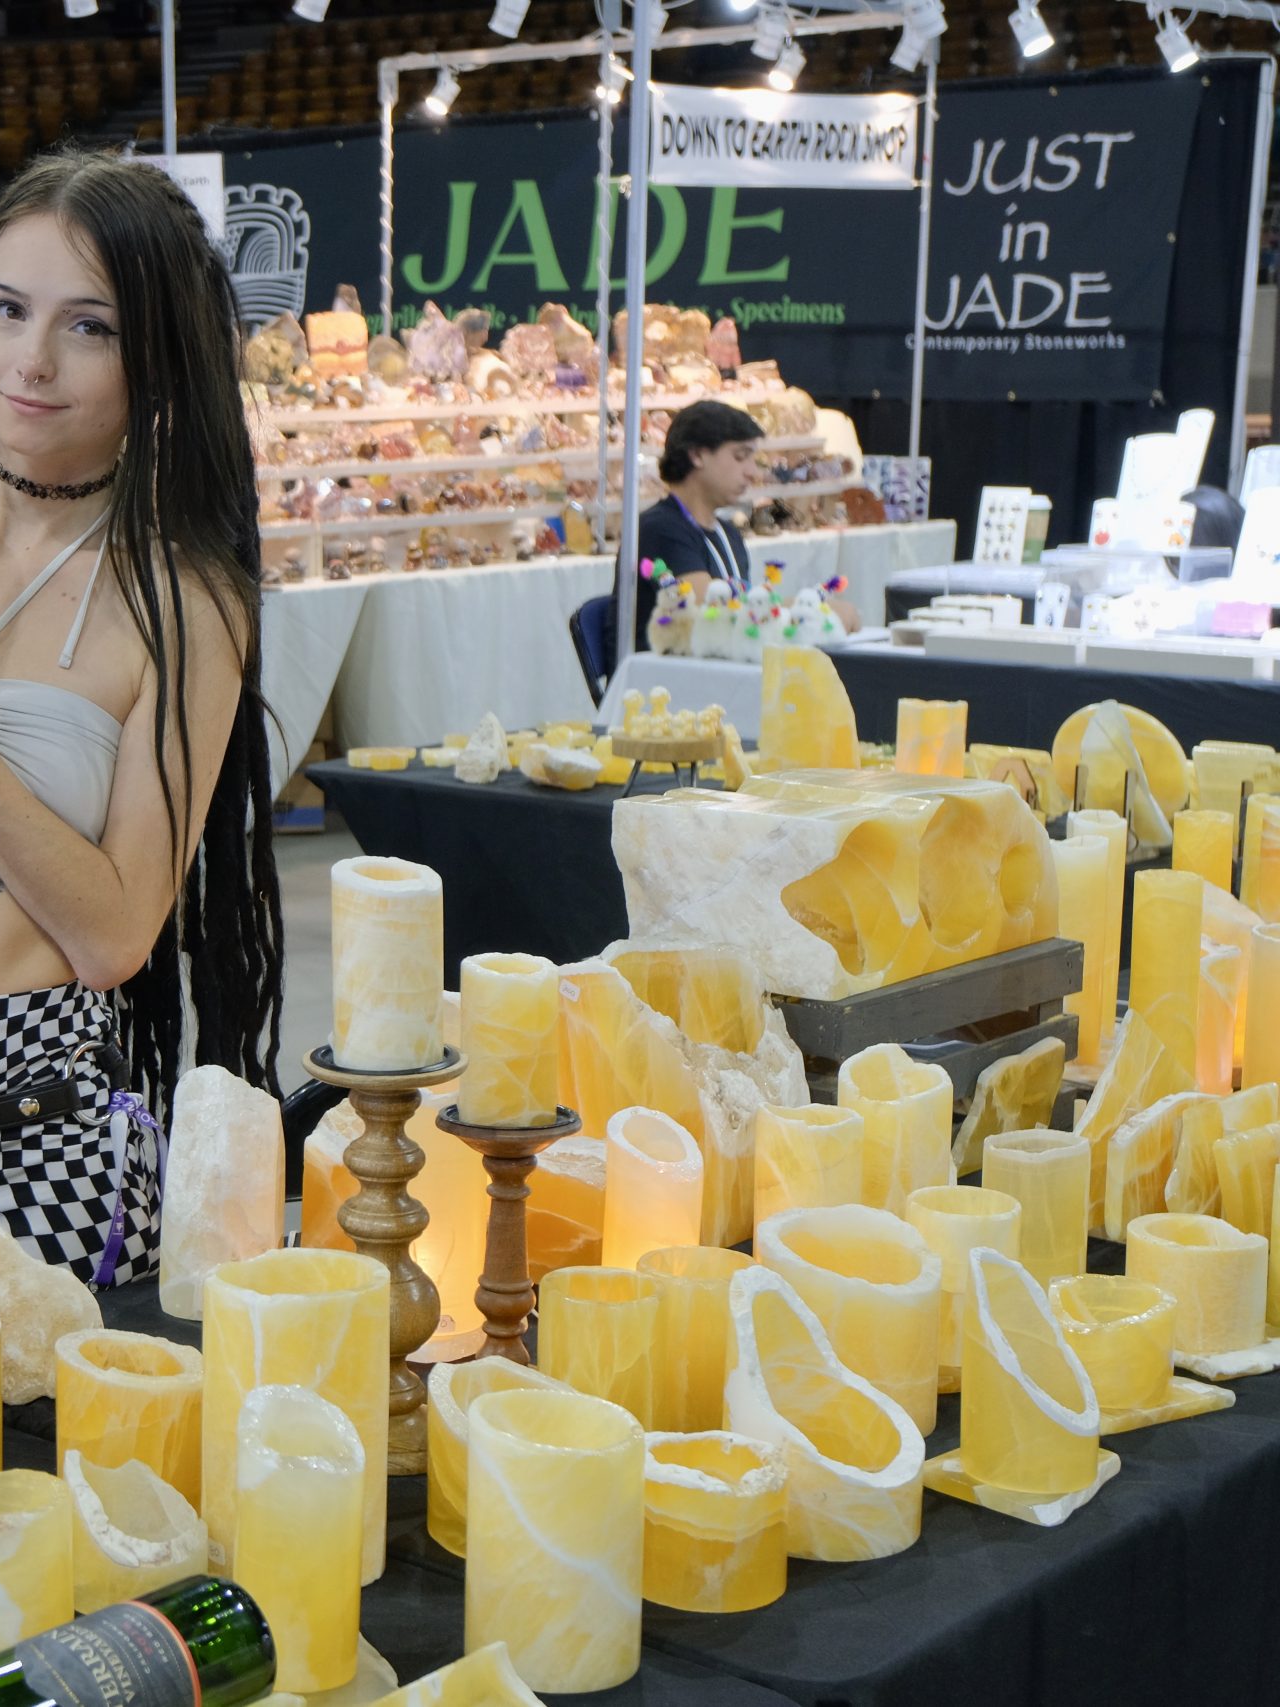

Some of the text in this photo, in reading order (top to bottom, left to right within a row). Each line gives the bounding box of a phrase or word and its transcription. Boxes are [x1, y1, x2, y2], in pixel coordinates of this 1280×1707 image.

[661, 115, 908, 161] DOWN TO EARTH ROCK SHOP
[943, 131, 1135, 196] JUST
[401, 180, 792, 294] JADE
[999, 202, 1049, 262] in
[731, 294, 845, 330] Specimens
[924, 272, 1112, 330] JADE
[905, 331, 1125, 354] Cntemporary Stoneworks
